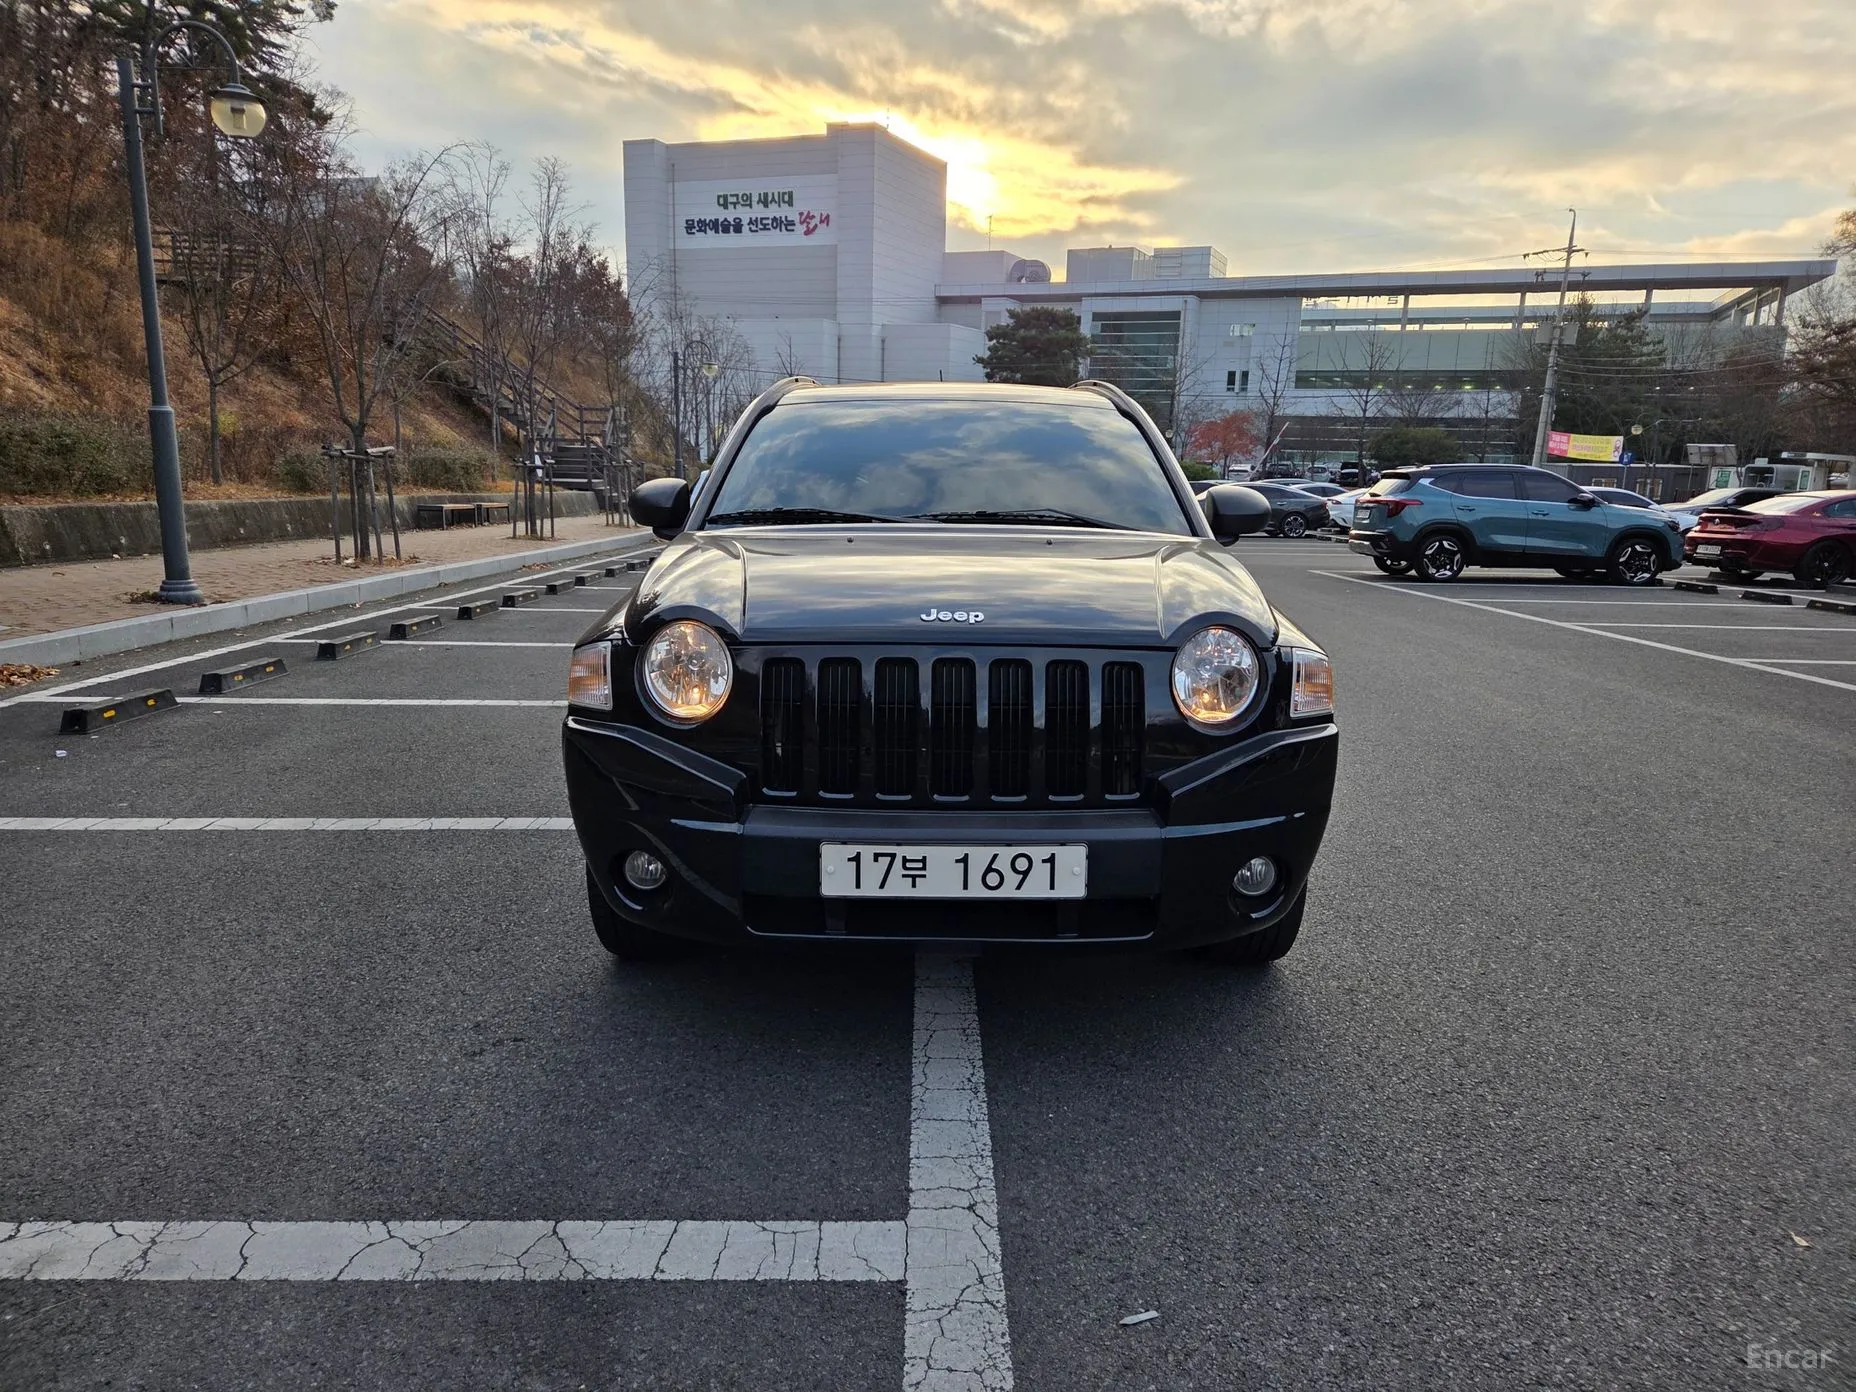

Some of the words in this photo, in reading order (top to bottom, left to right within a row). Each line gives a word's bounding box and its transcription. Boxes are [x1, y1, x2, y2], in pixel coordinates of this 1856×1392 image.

[716, 192, 753, 210] 대구의
[756, 190, 794, 209] 새시대
[684, 217, 744, 235] 문화예술을
[747, 215, 796, 234] 선도하는
[920, 608, 985, 624] Jeep
[846, 851, 927, 890] 17부
[953, 852, 1056, 891] 1691
